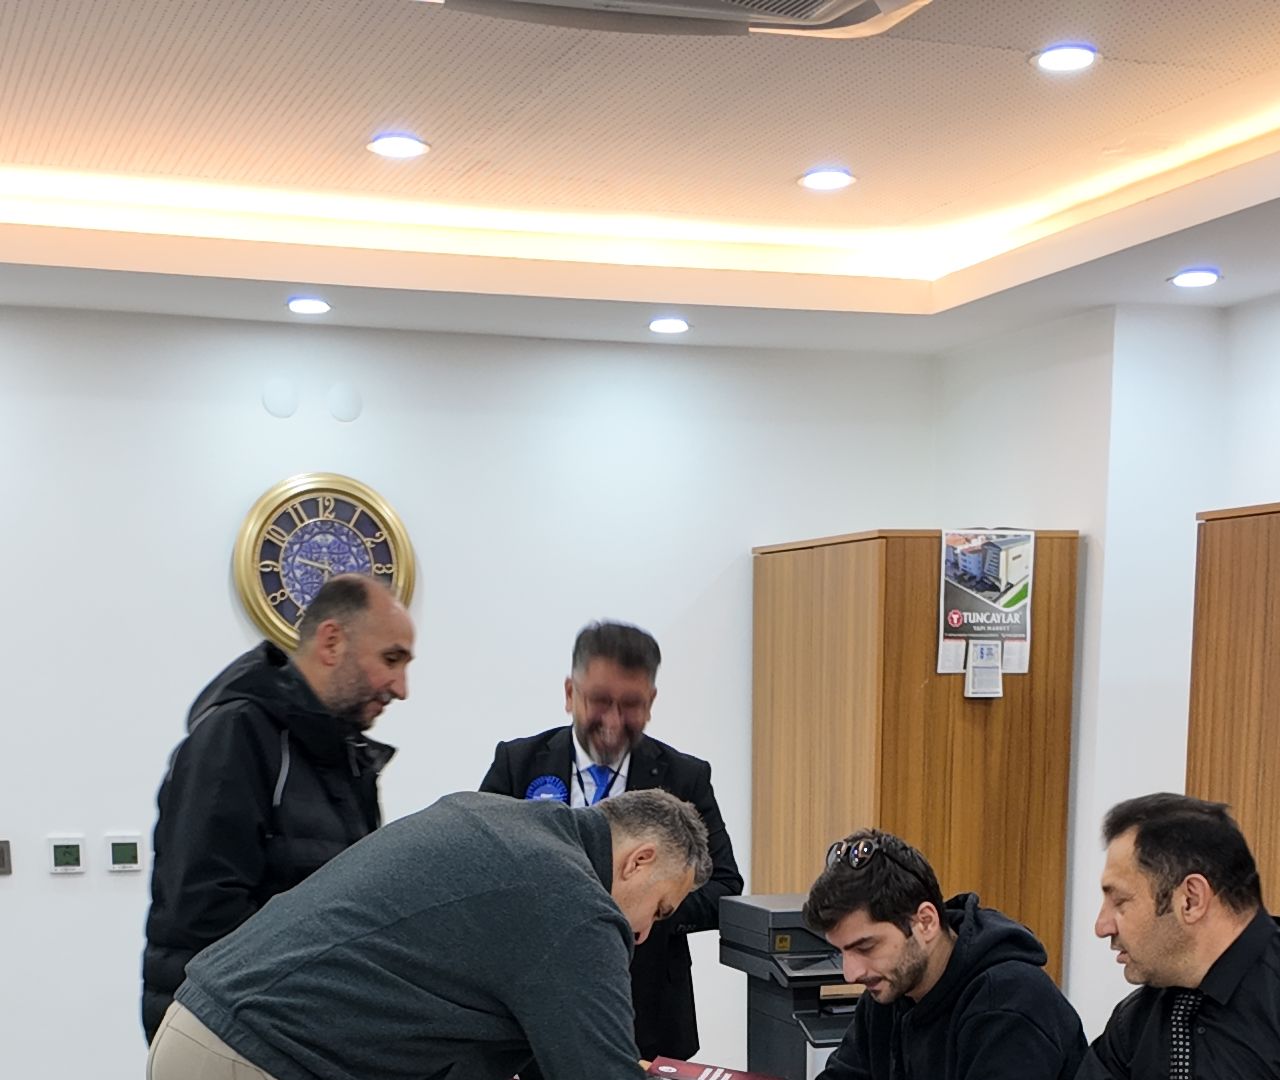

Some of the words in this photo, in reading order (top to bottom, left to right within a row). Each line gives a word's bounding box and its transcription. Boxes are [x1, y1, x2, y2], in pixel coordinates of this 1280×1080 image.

[285, 503, 308, 526] 11
[317, 497, 336, 519] 12
[349, 507, 363, 527] 1
[265, 525, 288, 547] 10
[363, 531, 387, 548] 2
[259, 560, 280, 572] 9
[268, 589, 288, 606] 8
[962, 612, 1021, 624] TUNCAYLAR
